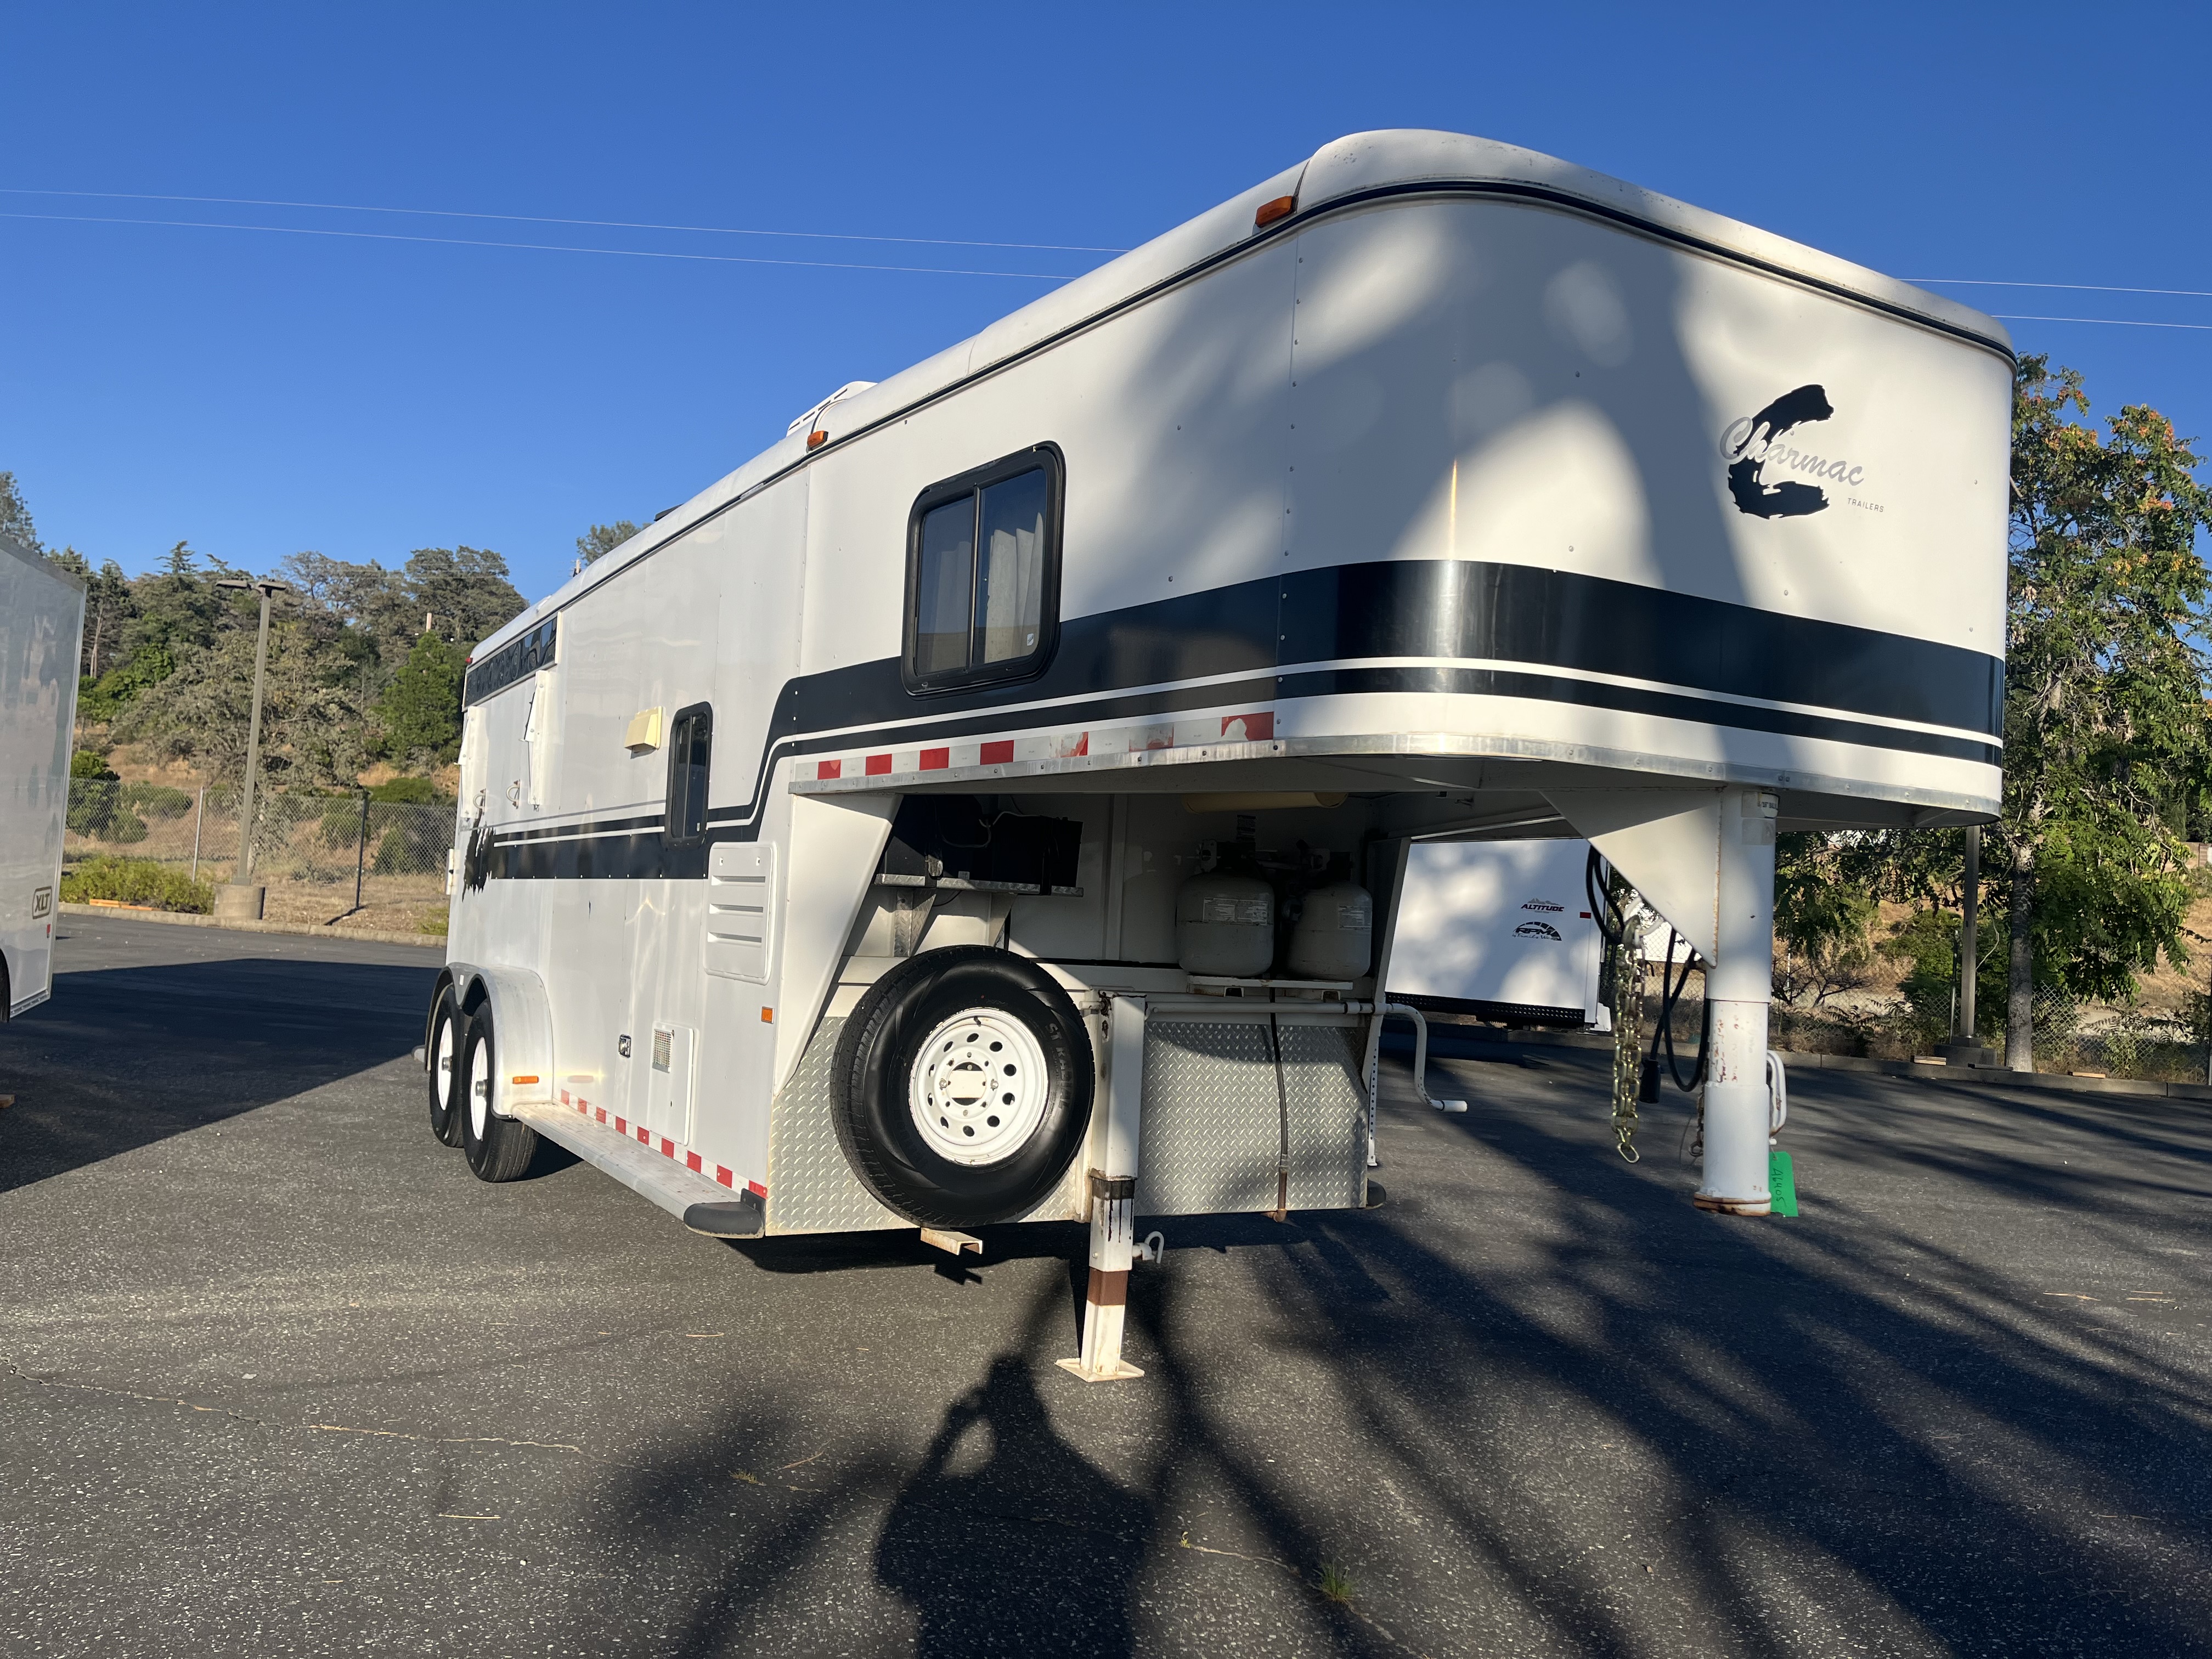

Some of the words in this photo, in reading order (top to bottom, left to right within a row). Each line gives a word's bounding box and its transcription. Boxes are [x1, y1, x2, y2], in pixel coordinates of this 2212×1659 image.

[1719, 416, 1864, 486] Charmac
[1847, 497, 1884, 512] TRAILERS
[35, 893, 50, 913] XLT
[1520, 904, 1565, 912] ALTITUDE
[1515, 927, 1554, 935] RPM
[1045, 1023, 1063, 1041] ST
[1056, 1047, 1073, 1109] RADIAL
